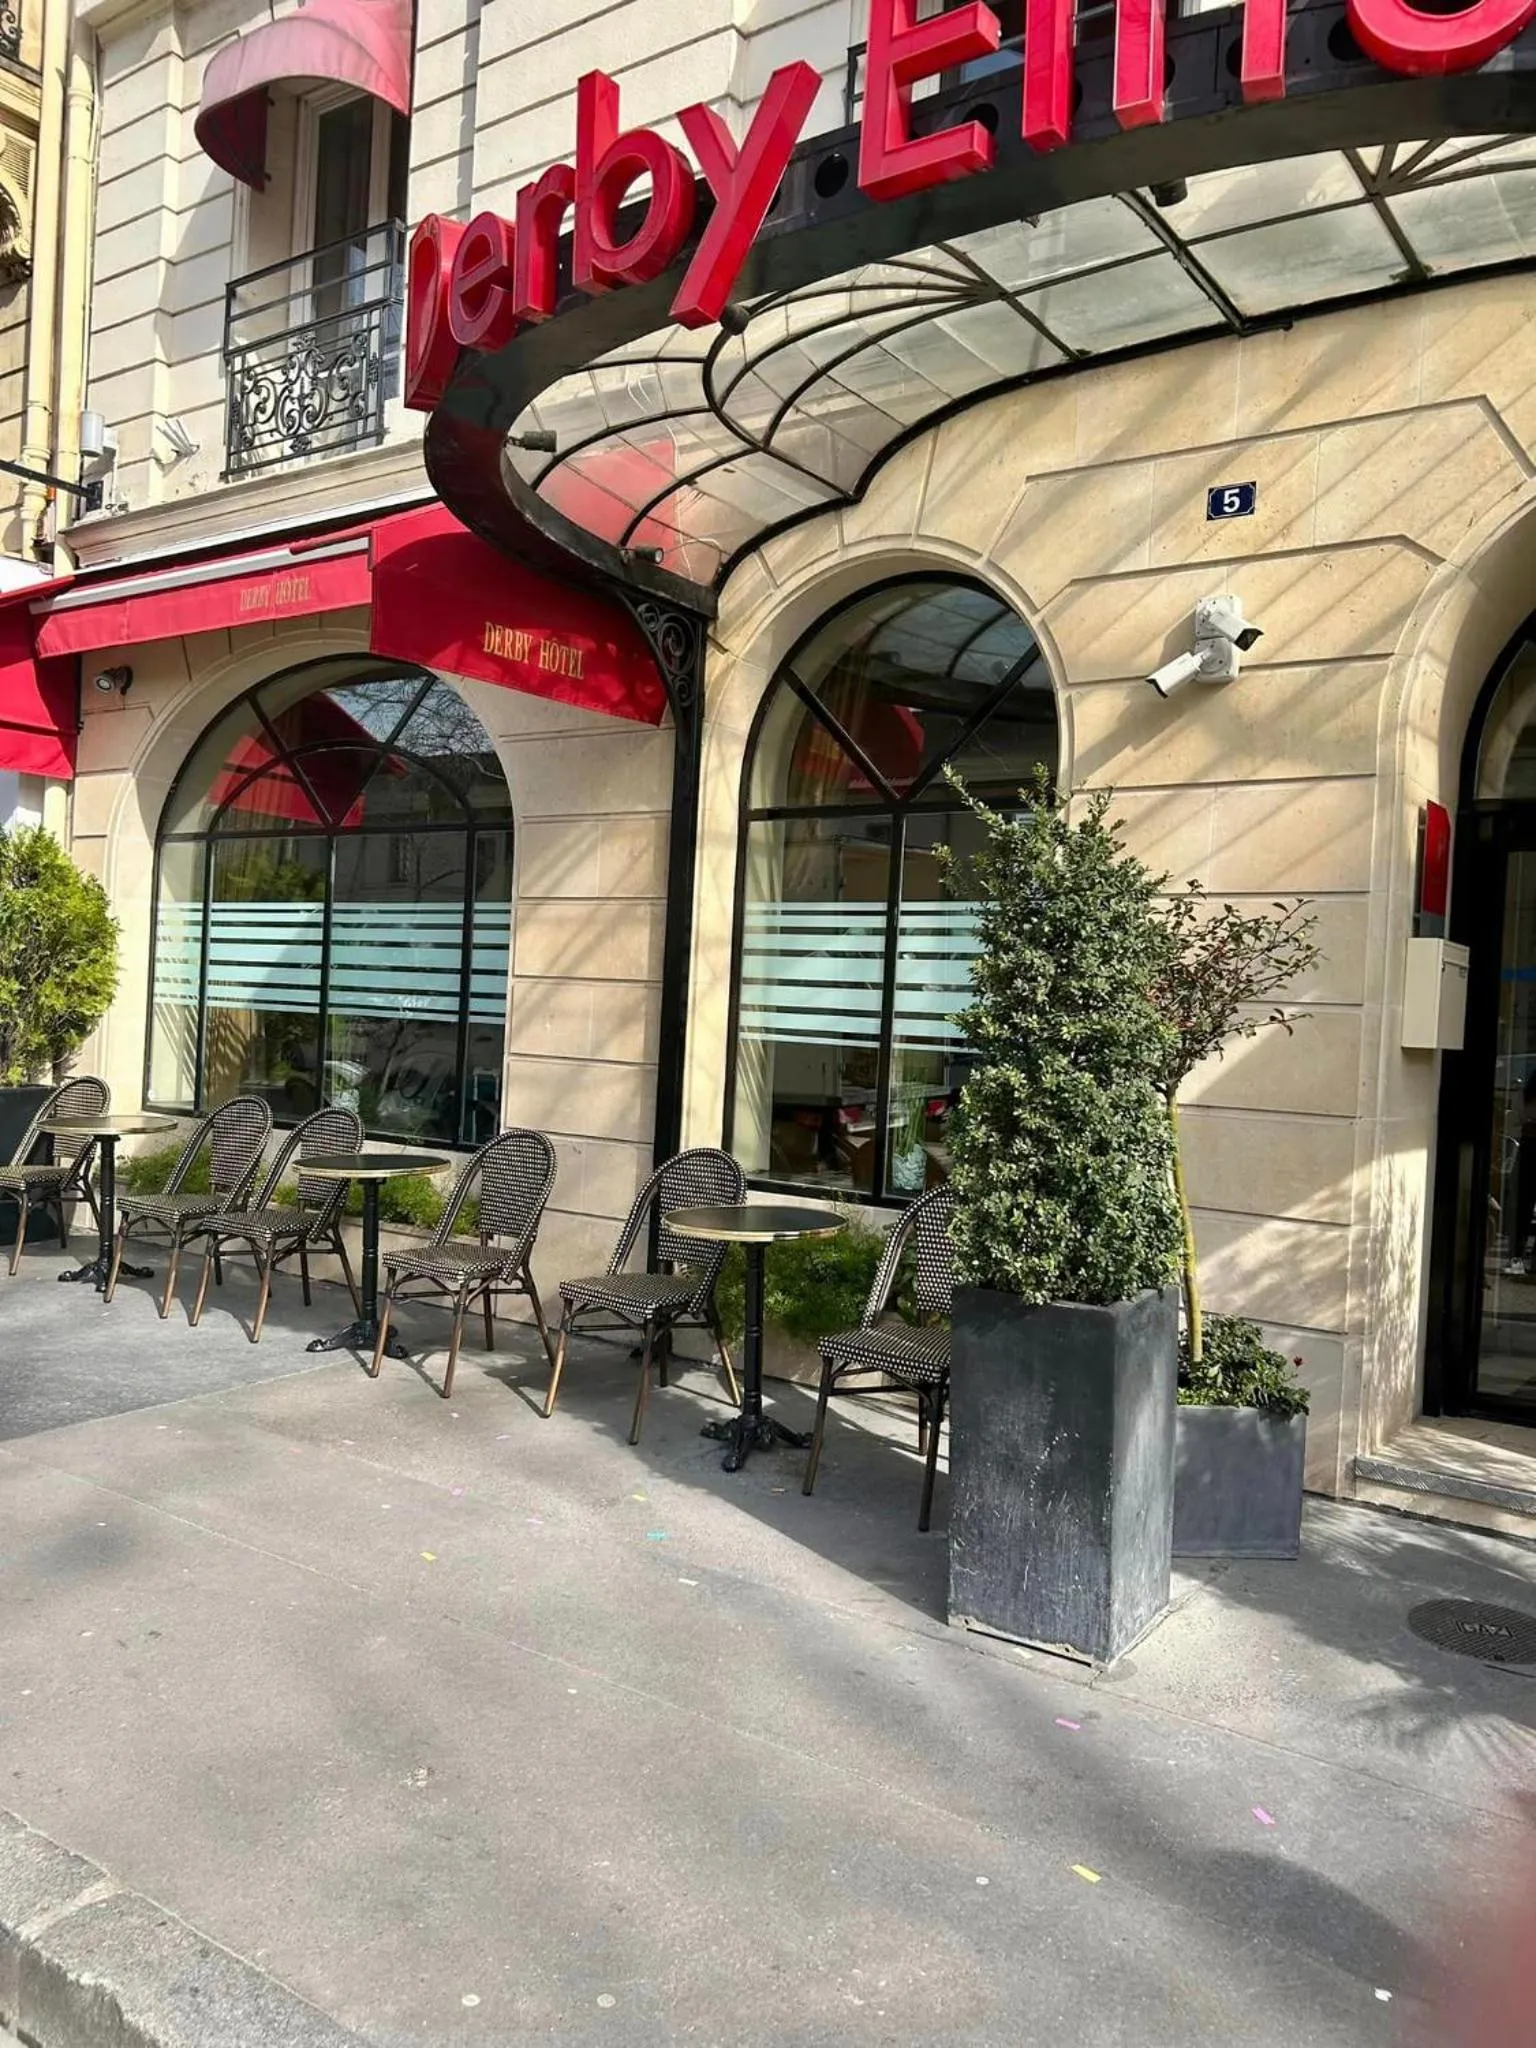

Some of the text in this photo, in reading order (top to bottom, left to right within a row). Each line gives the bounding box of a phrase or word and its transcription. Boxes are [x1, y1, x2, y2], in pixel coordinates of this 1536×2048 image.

[1223, 488, 1240, 513] 5
[240, 585, 271, 612] DERBY
[483, 621, 584, 680] DERBY HÔTEL
